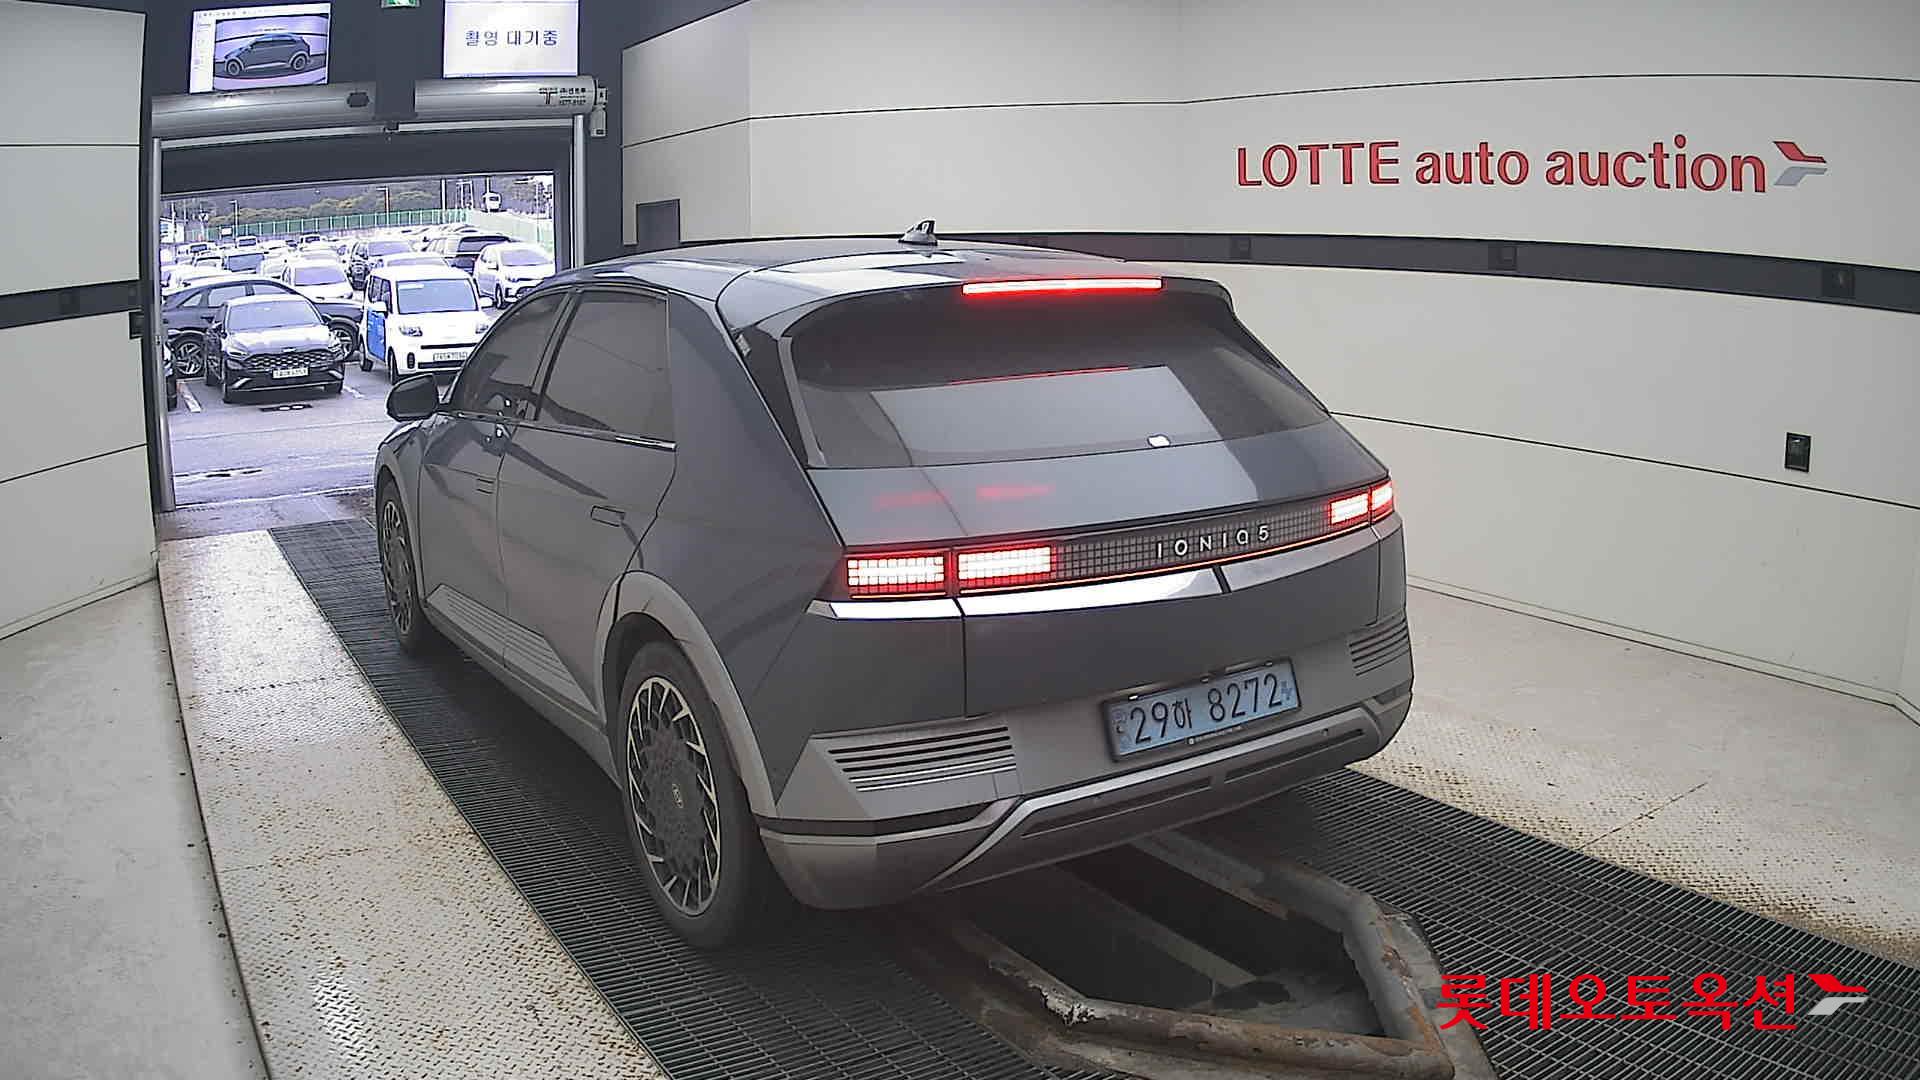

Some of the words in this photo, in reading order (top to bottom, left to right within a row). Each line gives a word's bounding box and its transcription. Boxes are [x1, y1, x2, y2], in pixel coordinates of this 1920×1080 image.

[465, 30, 498, 47] 촬영
[506, 29, 558, 47] 대기중
[1237, 141, 1400, 187] LOTTE
[1415, 141, 1529, 186] auto
[1545, 134, 1767, 193] auction
[1130, 698, 1193, 746] 29하
[1207, 672, 1282, 722] 8272
